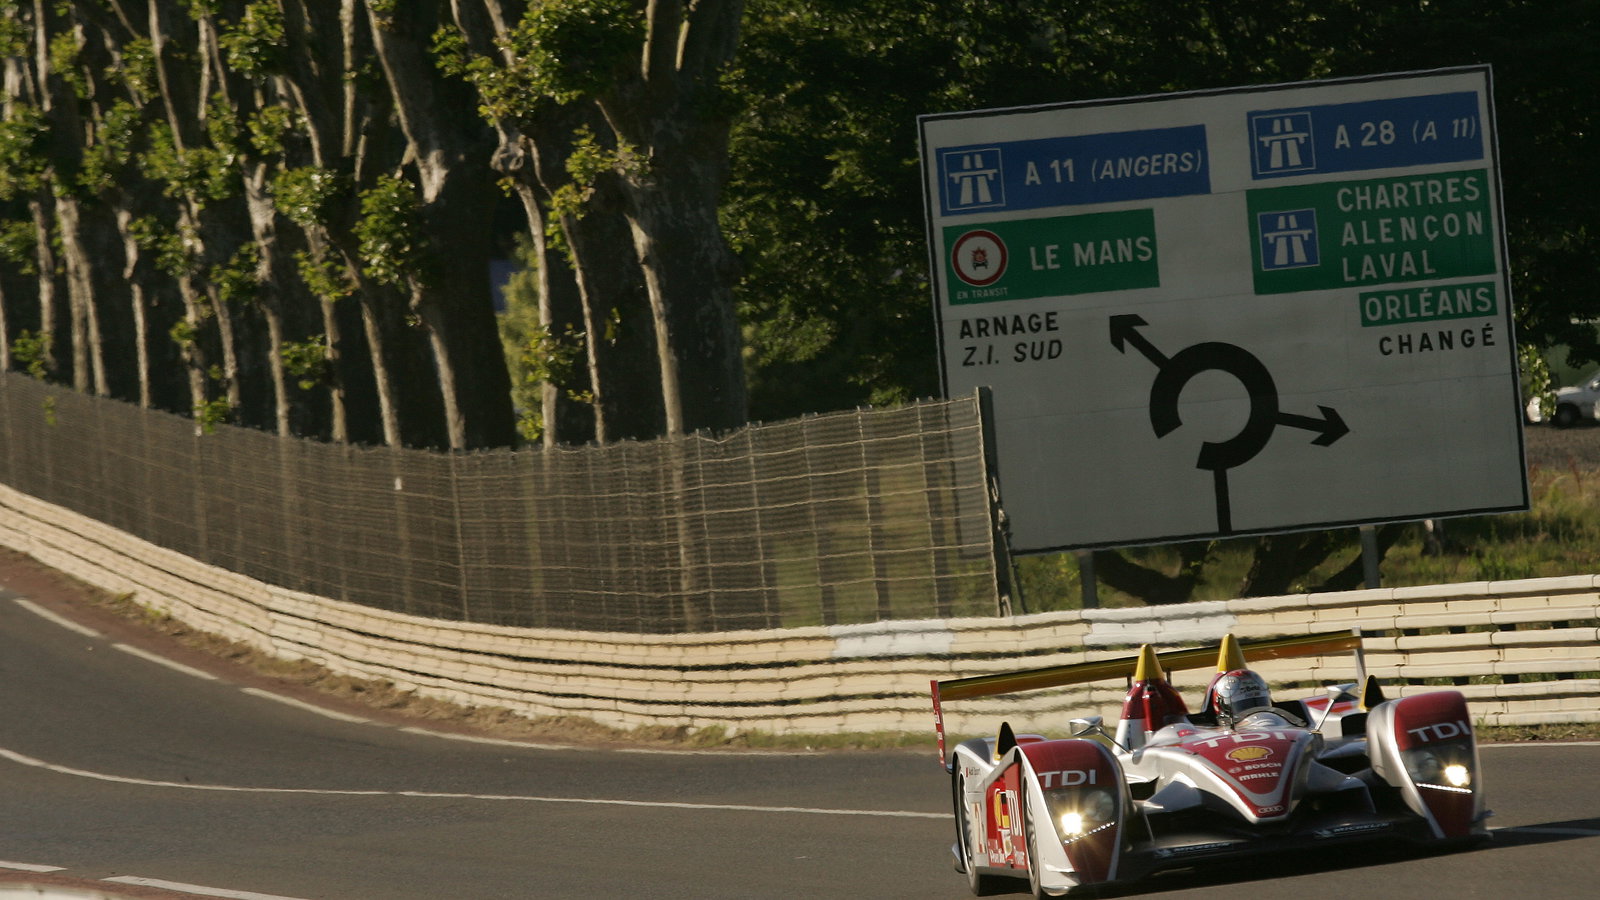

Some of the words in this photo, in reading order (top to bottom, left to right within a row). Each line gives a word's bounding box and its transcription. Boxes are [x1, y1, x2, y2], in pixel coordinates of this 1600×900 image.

[1335, 124, 1351, 149] A
[1360, 120, 1396, 147] 28
[1412, 119, 1438, 144] (A
[1452, 116, 1476, 140] 11)
[1024, 161, 1042, 186] A
[1050, 158, 1075, 184] 11
[1091, 149, 1202, 182] (ANGERS)
[1336, 176, 1480, 213] CHARTRES
[1341, 211, 1484, 247] ALENÇON
[1029, 244, 1061, 271] LE
[1073, 236, 1153, 267] MANS
[1342, 249, 1436, 282] LAVAL
[956, 290, 969, 300] EN
[970, 287, 1009, 299] TRANSIT
[1364, 287, 1493, 321] ORLÉANS
[959, 311, 1059, 340] ARNAGE
[1378, 323, 1496, 356] CHANGÉ
[962, 344, 1000, 367] Z.I.
[1013, 339, 1063, 363] SUD
[1192, 731, 1288, 749] TDI
[1405, 720, 1472, 743] TDI
[1036, 769, 1097, 788] TDI
[1239, 772, 1279, 781] MAHLE
[1244, 762, 1282, 771] BOSCH
